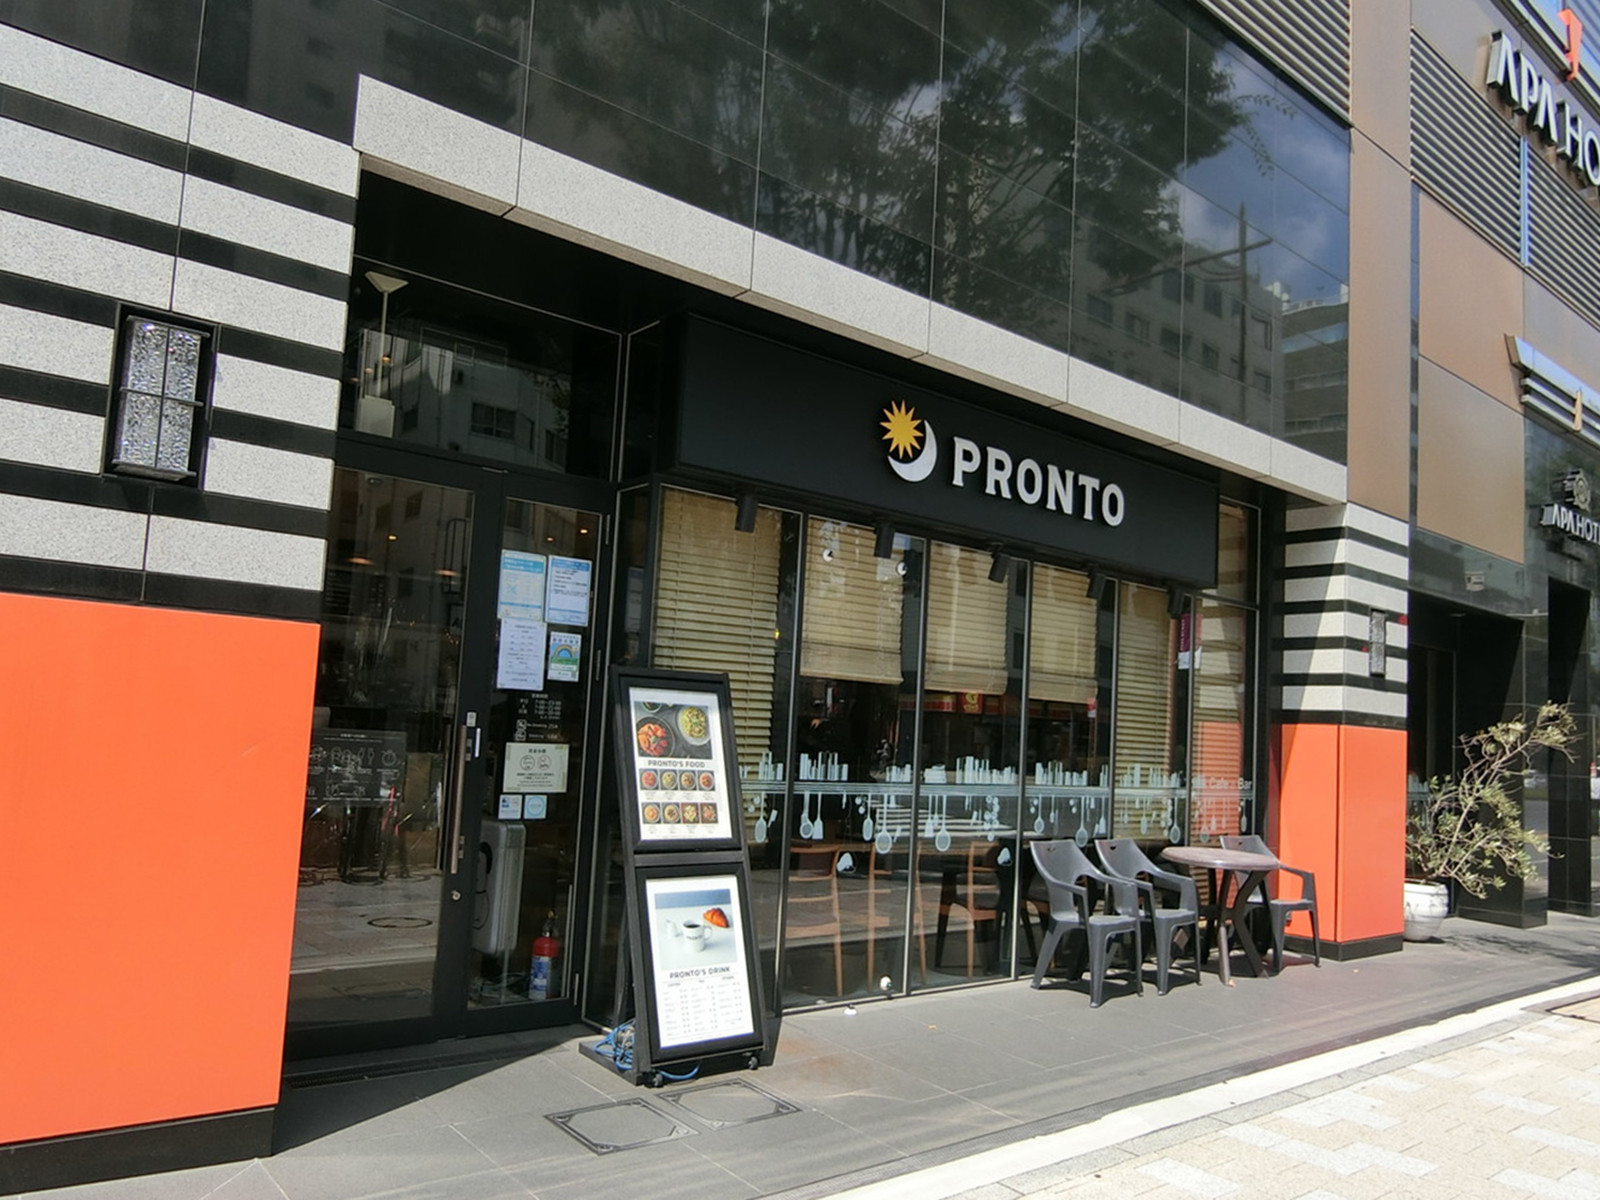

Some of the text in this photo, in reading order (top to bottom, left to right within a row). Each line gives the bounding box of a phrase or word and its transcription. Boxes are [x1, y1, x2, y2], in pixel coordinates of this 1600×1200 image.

[1487, 31, 1558, 146] APA
[952, 436, 1125, 527] PRONTO
[648, 759, 706, 768] PRONTO'S FOOD
[669, 966, 730, 979] PRONTO'S DRINK
